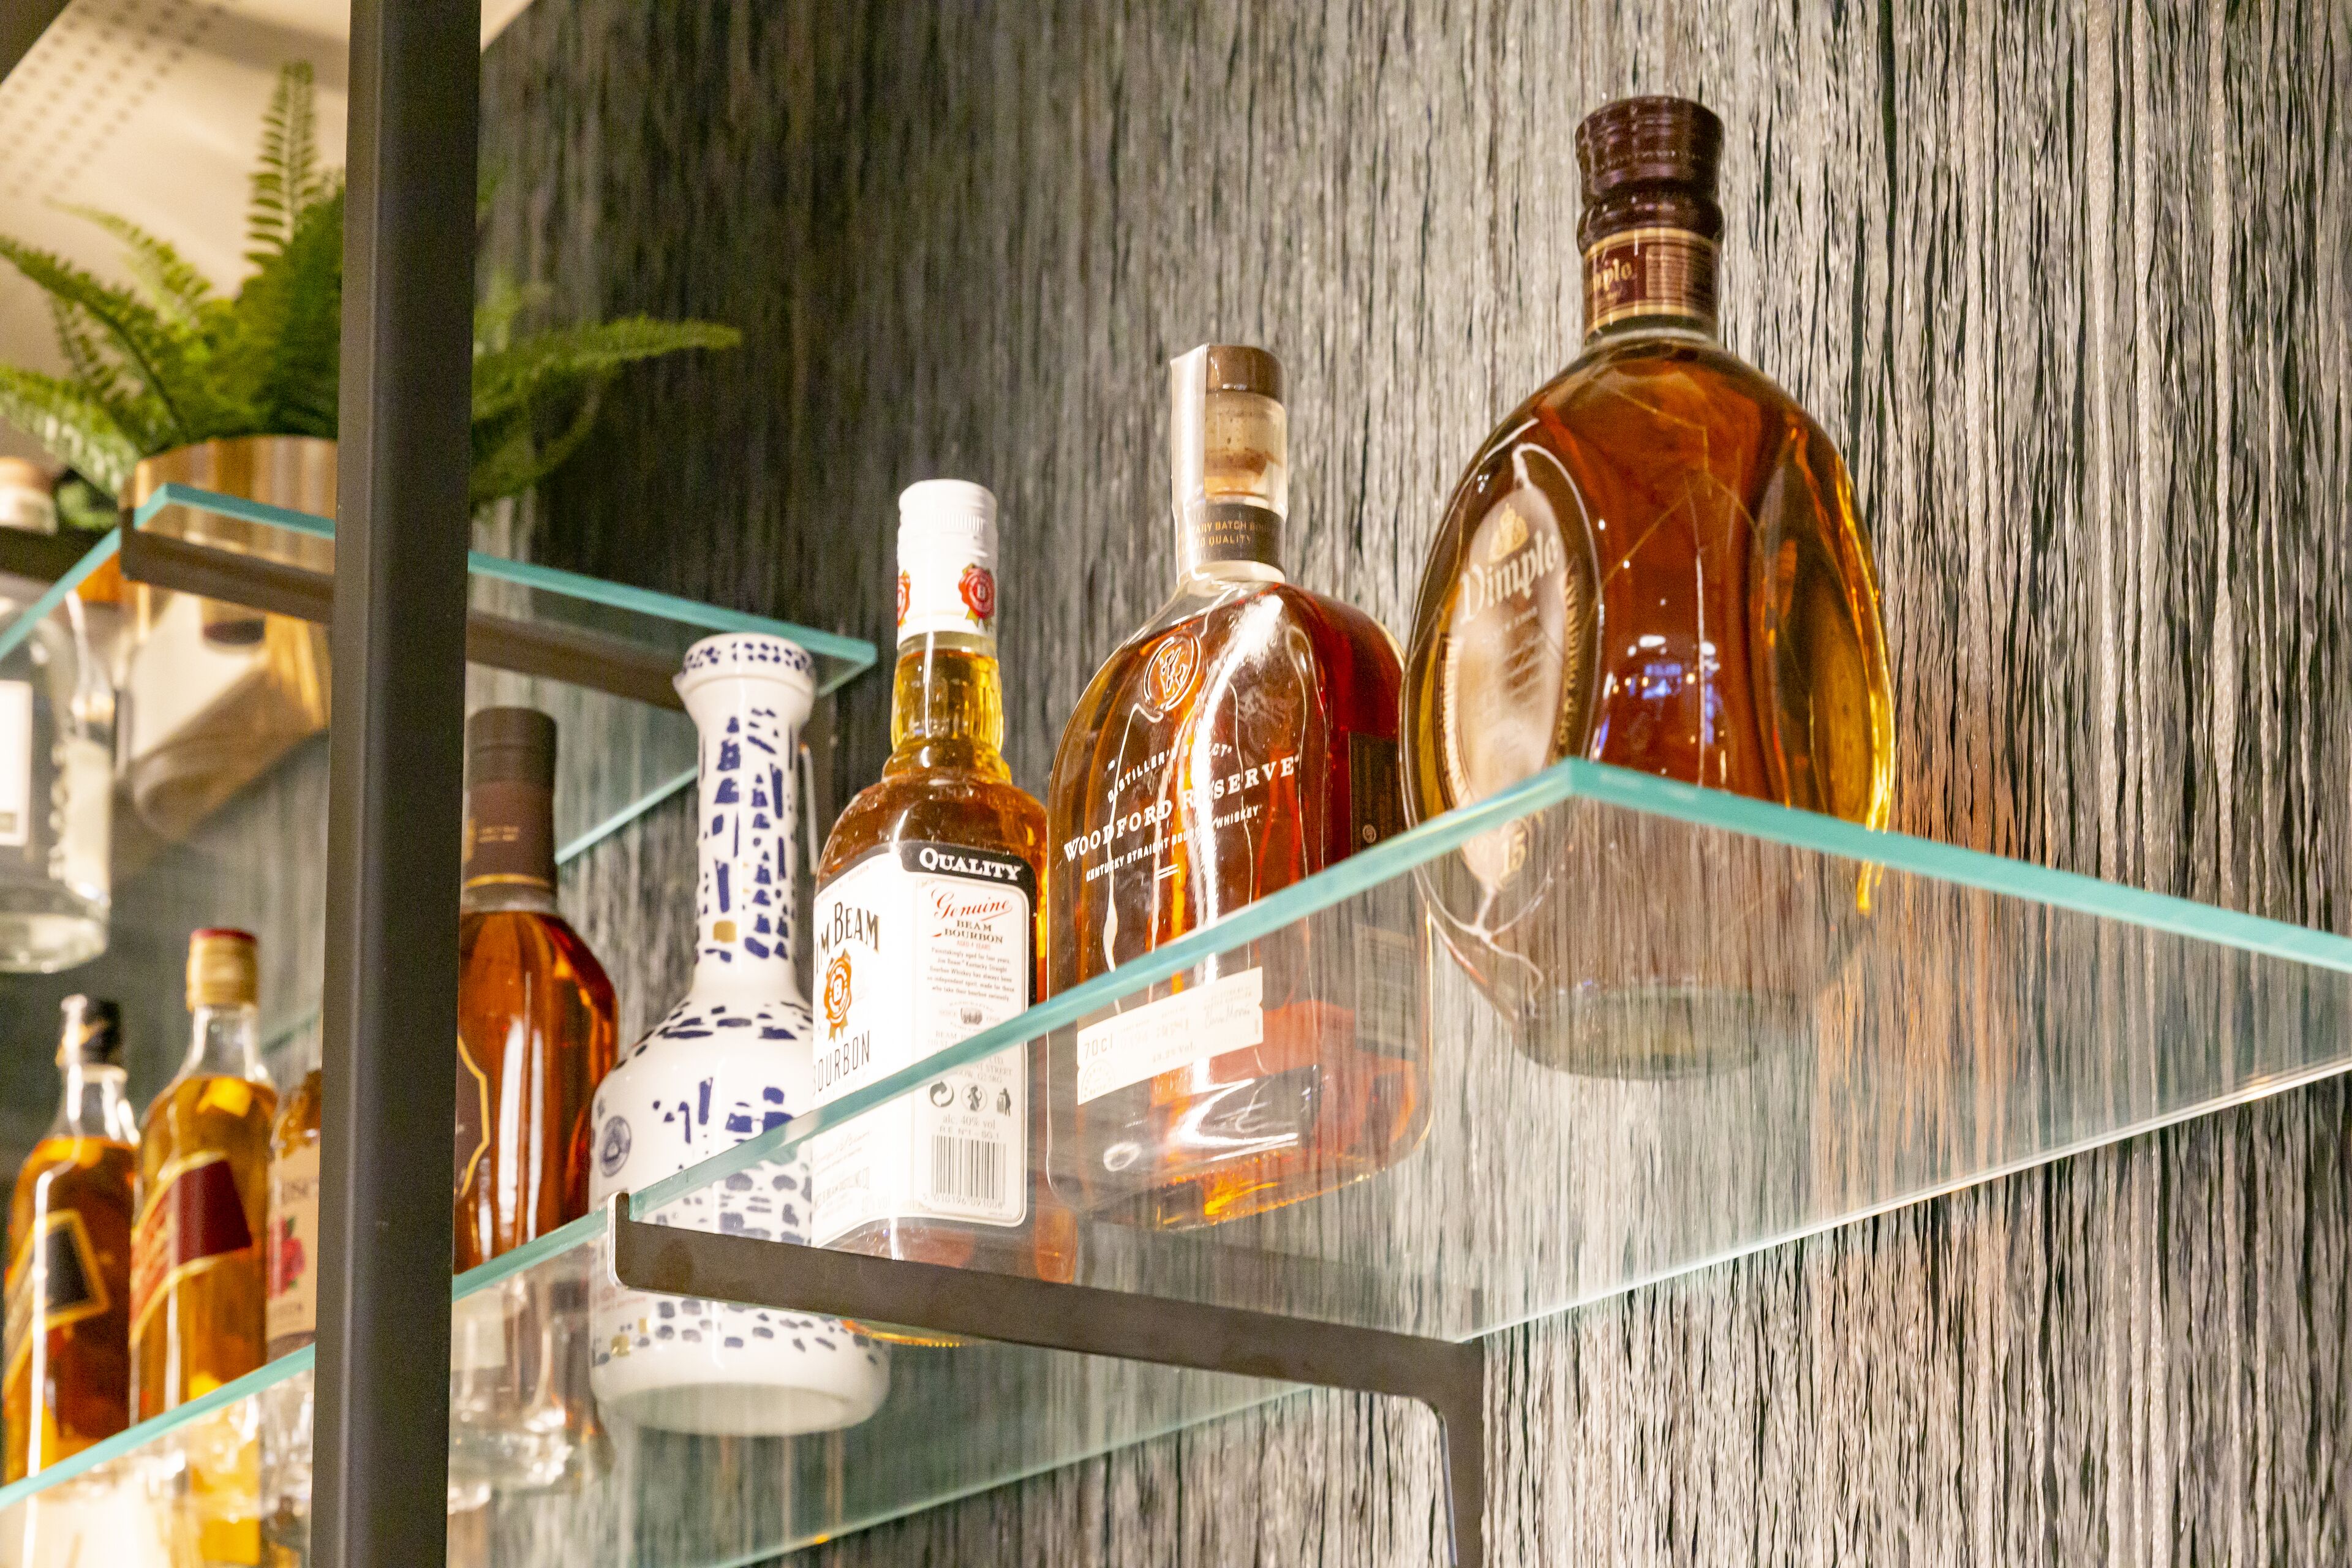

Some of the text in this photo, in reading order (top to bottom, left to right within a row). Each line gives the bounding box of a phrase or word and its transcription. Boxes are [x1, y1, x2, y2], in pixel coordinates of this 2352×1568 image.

[1208, 533, 1251, 546] QUALITY
[1460, 530, 1558, 625] Dimple
[1064, 755, 1294, 862] WOODFORD RSERVE
[919, 847, 1022, 880] QUALITY
[1086, 856, 1124, 882] KENTUCKY
[931, 888, 1012, 920] Genuine
[816, 901, 879, 975] IM BEAM
[944, 929, 1003, 944] BOURBON
[957, 920, 992, 932] BEAM
[961, 1115, 980, 1127] 40%
[982, 1119, 996, 1129] vol
